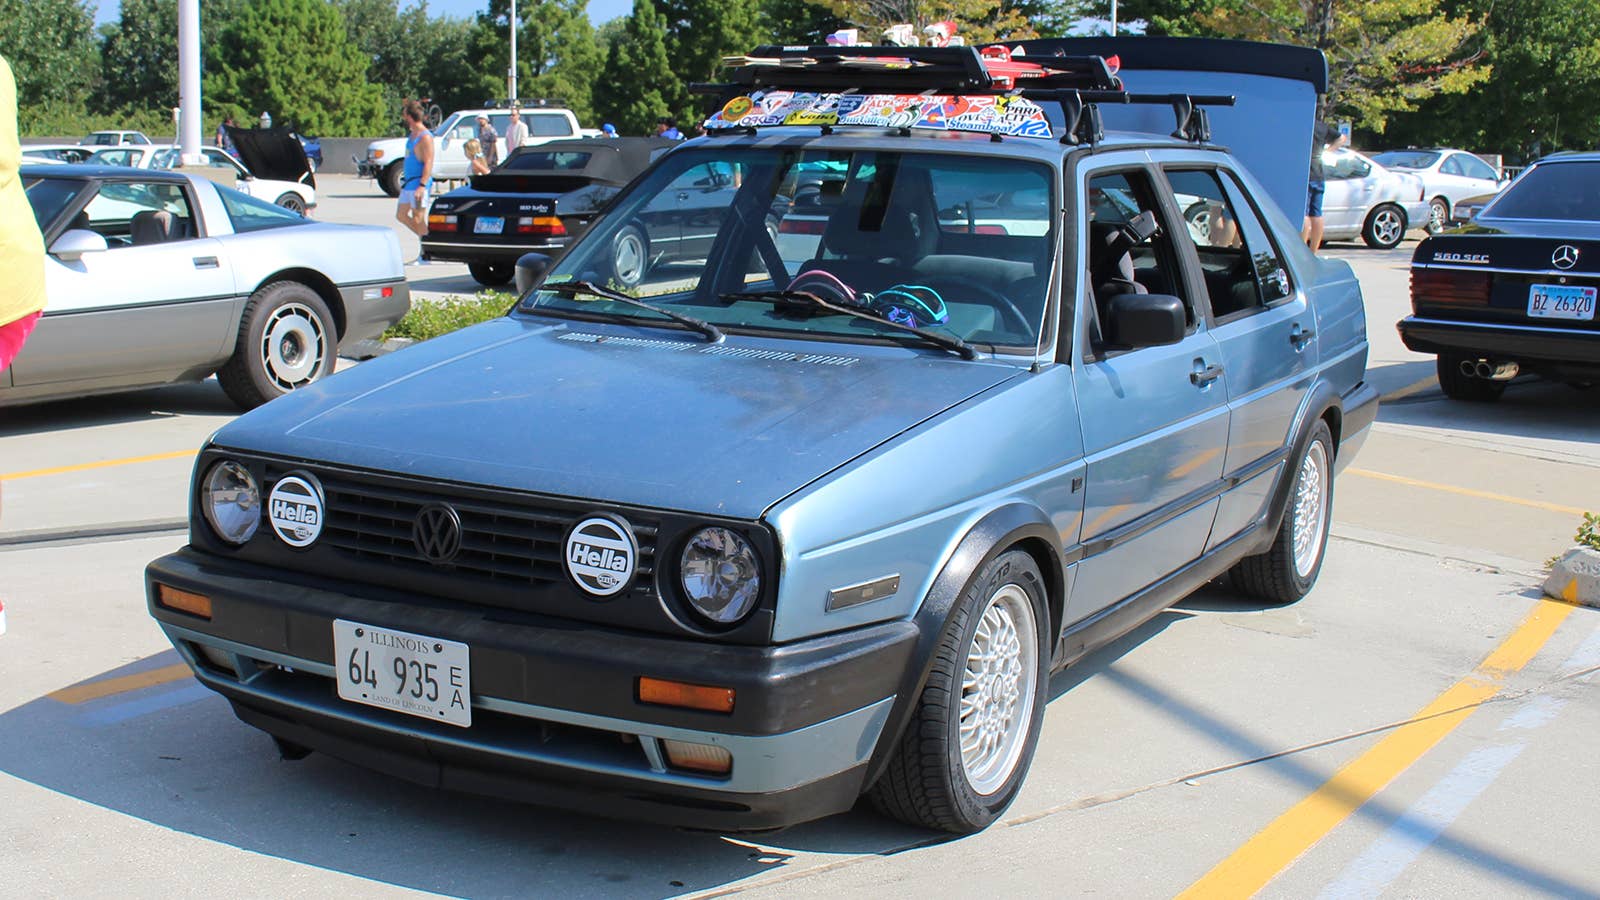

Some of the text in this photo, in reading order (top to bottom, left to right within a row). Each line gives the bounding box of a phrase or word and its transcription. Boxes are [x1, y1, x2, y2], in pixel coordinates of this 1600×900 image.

[741, 115, 784, 125] OAKLEY
[948, 118, 1013, 133] Steamboat
[1010, 120, 1048, 135] K2
[1433, 251, 1490, 262] 560 SEC
[1532, 294, 1592, 313] BZ 26320
[273, 500, 317, 524] Hella
[572, 542, 627, 572] Hella
[370, 631, 430, 654] ILLINOIS
[348, 647, 439, 702] 64 935
